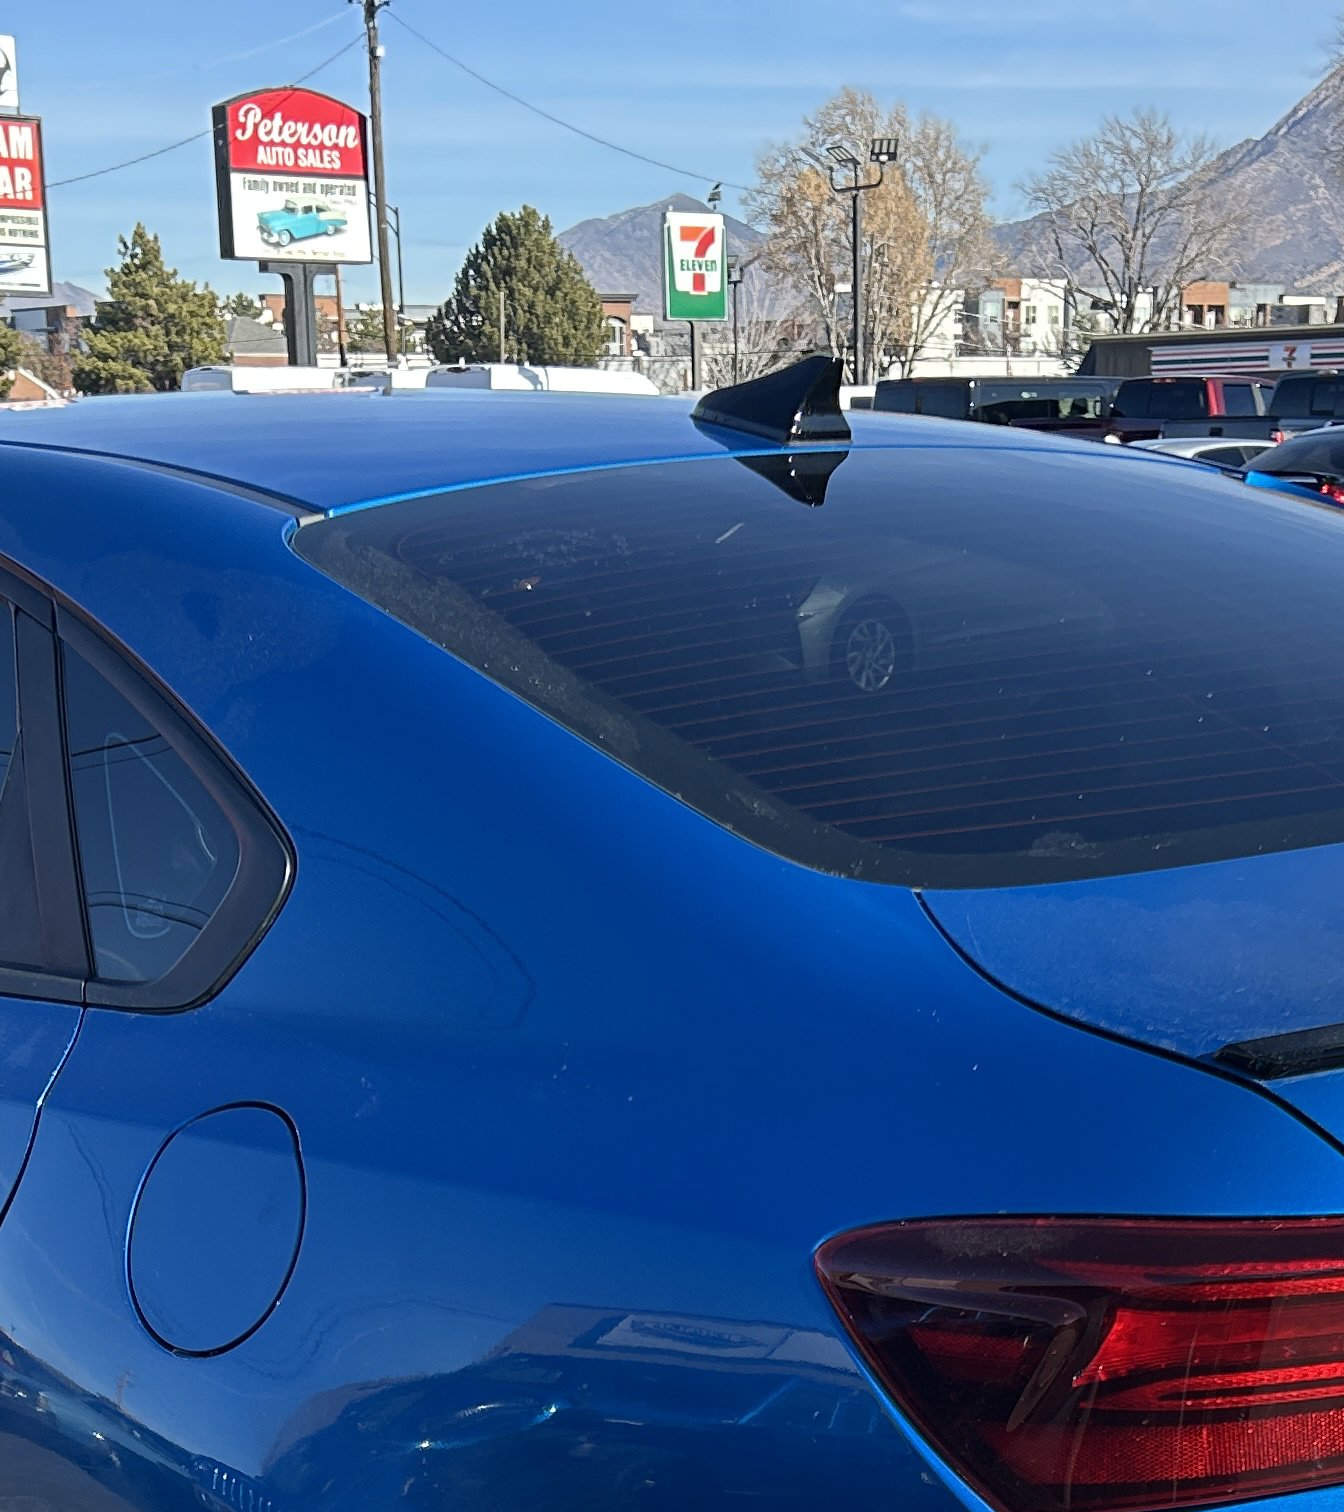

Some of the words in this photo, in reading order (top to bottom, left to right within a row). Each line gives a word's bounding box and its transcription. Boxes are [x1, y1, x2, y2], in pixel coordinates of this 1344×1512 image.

[236, 103, 358, 149] Peterson
[257, 145, 295, 167] AUTO
[297, 148, 342, 169] SALES
[273, 181, 299, 193] owned
[303, 183, 316, 194] and
[680, 226, 715, 291] 7
